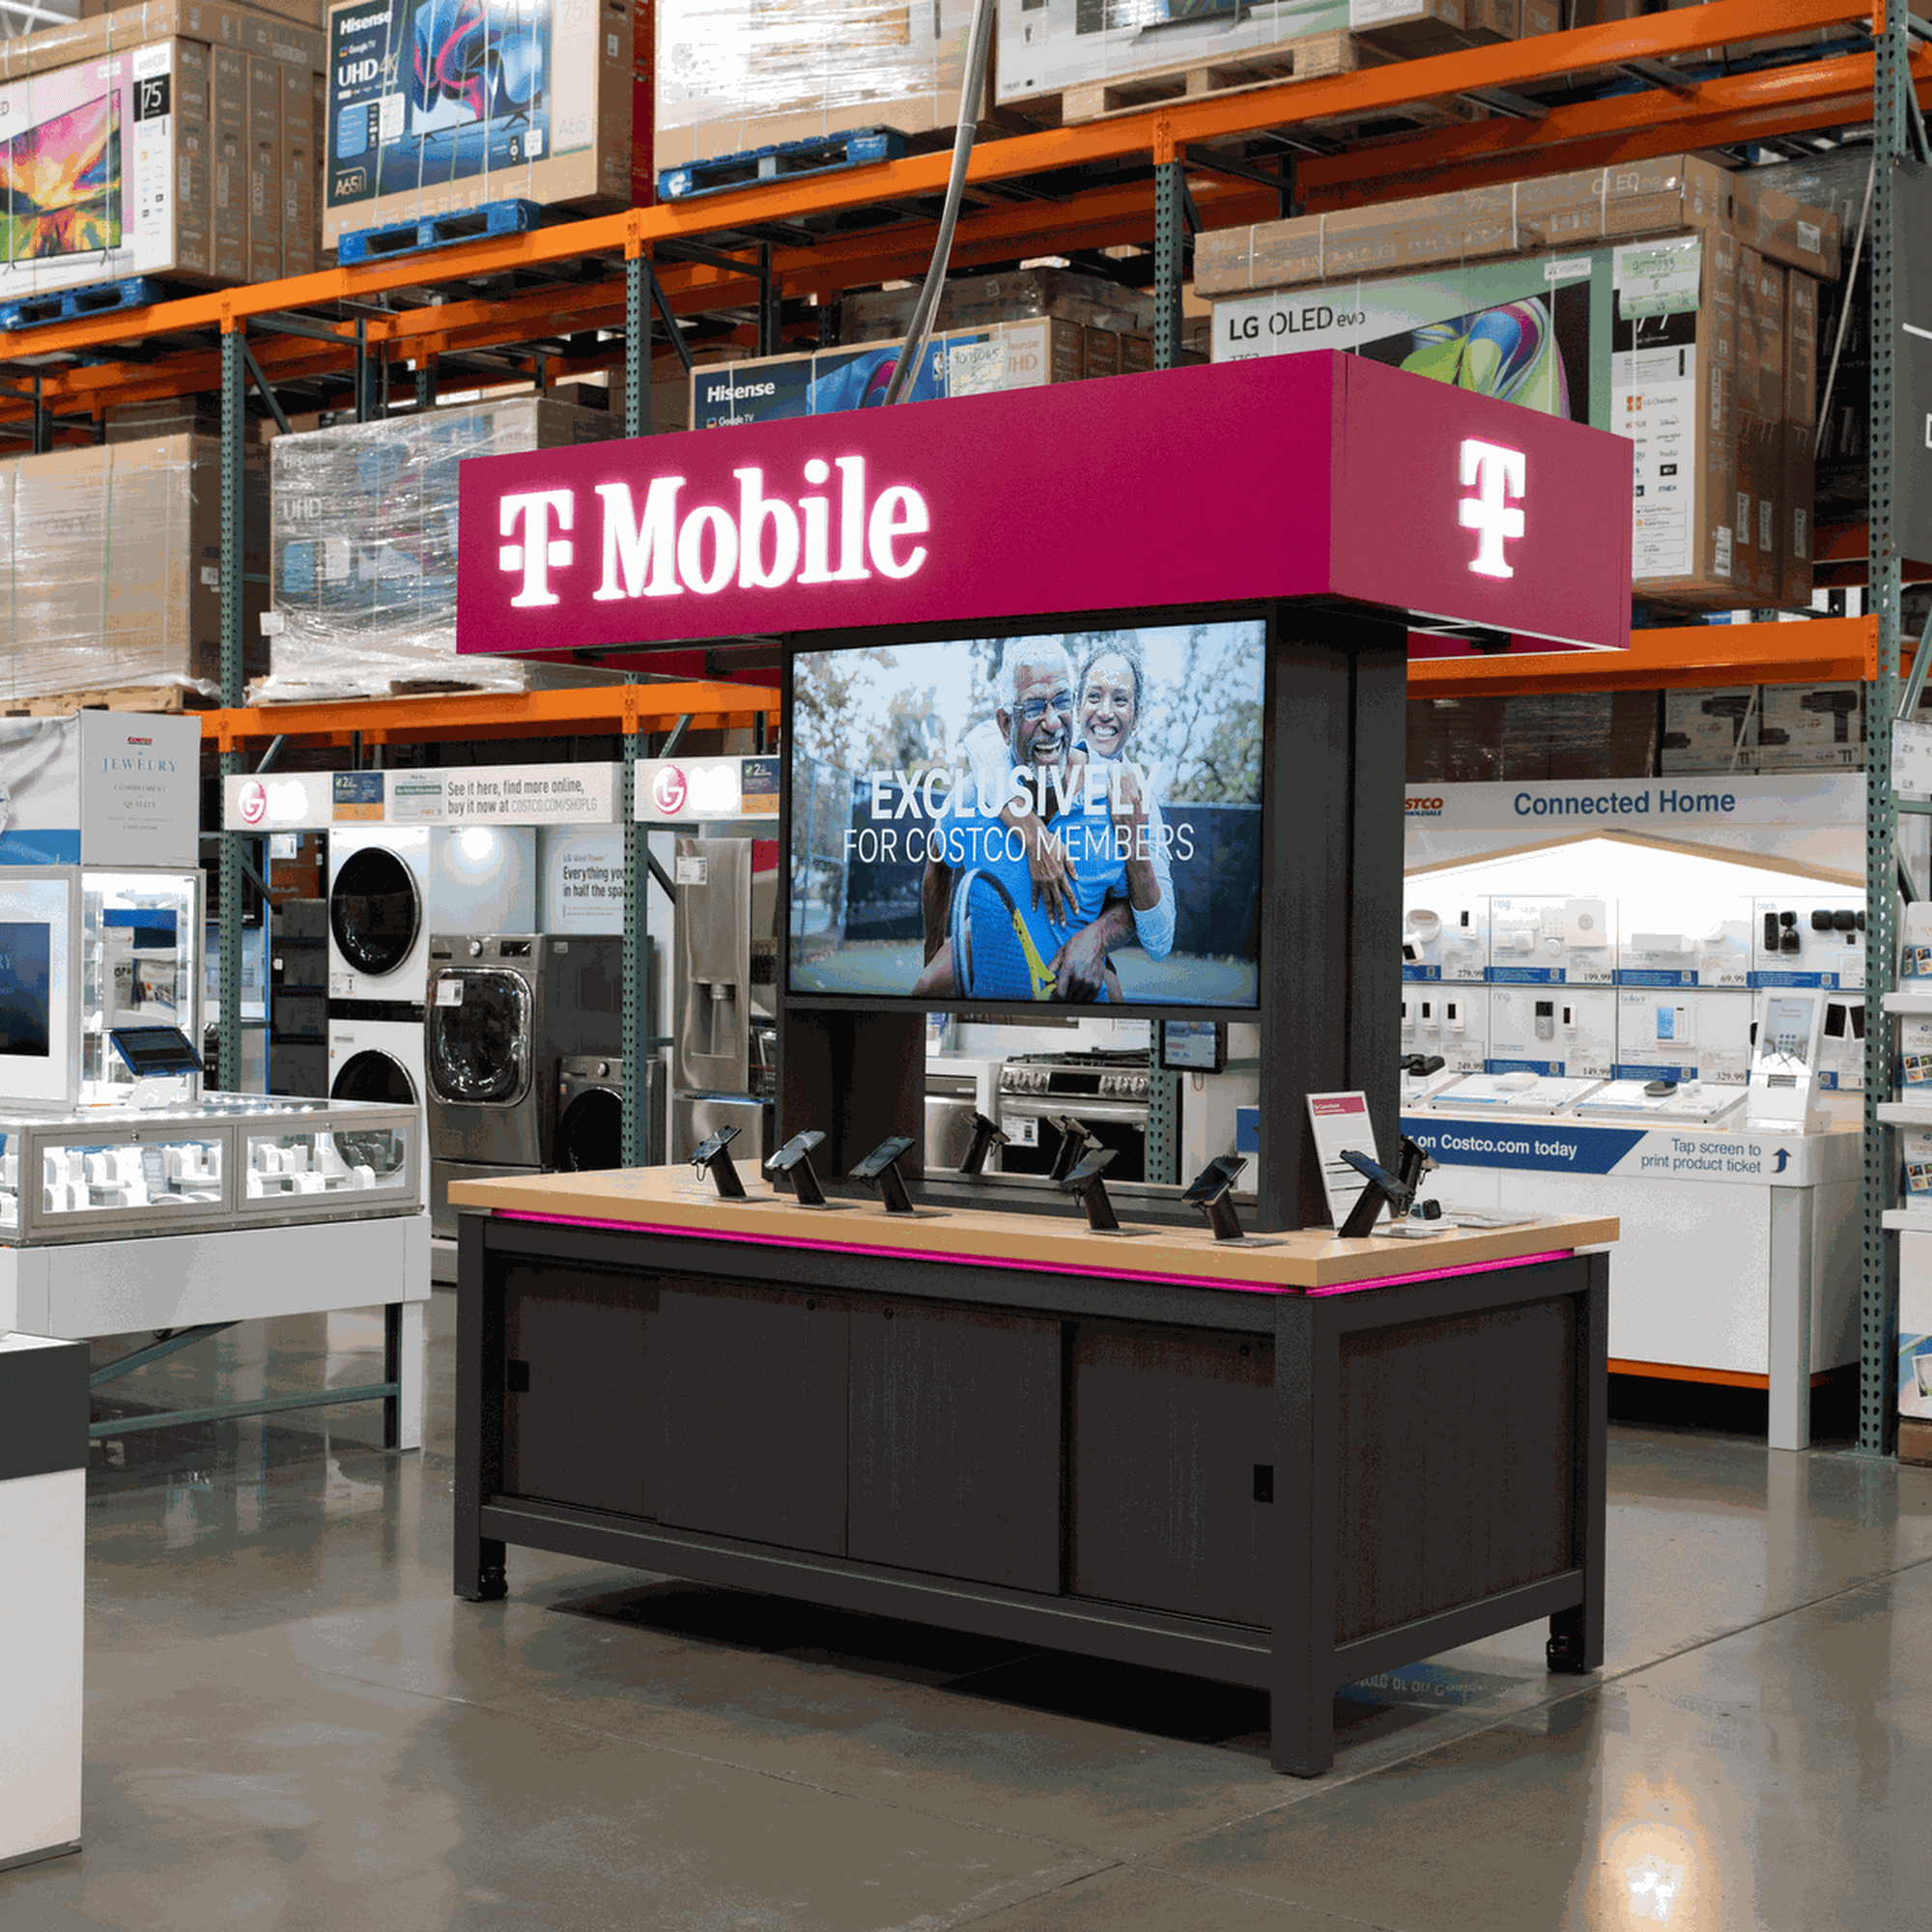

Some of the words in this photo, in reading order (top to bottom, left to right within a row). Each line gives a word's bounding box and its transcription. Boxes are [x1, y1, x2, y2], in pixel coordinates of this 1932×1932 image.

[340, 11, 390, 35] Hisense
[338, 59, 379, 87] UHD
[142, 80, 164, 109] 75
[1230, 316, 1259, 341] LG
[1268, 306, 1334, 335] OLED
[1337, 311, 1366, 327] evo
[707, 381, 776, 403] Hisense
[593, 455, 930, 602] Mobile
[100, 757, 177, 773] JEWELRY
[447, 781, 466, 797] See
[468, 781, 474, 795] it
[476, 780, 501, 797] here,
[503, 779, 522, 795] find
[525, 781, 549, 794] more
[552, 777, 584, 794] online,
[870, 762, 1160, 819] EXCLUSIVELY
[447, 800, 465, 817] buy
[468, 800, 474, 813] it
[476, 802, 497, 814] now
[499, 800, 509, 812] at
[1514, 789, 1650, 816] Connected
[1660, 789, 1736, 812] Home
[843, 829, 898, 863] FOR
[905, 826, 1027, 864] COSTCO
[1037, 823, 1196, 862] MEMBERS
[563, 866, 610, 883] Everything
[563, 883, 572, 896] in
[573, 883, 589, 897] half
[591, 883, 606, 897] the
[1583, 972, 1611, 981] 199.99
[1719, 974, 1745, 983] 69.99
[1458, 1062, 1484, 1071] 249.99
[1583, 1066, 1611, 1077] 149.99
[1715, 1070, 1745, 1081] 329.99
[1417, 1136, 1436, 1149] on
[1440, 1134, 1530, 1154] Costco.com
[1535, 1140, 1577, 1160] today
[1672, 1138, 1695, 1155] Tap
[1699, 1142, 1745, 1156] screen
[1749, 1143, 1762, 1157] to
[1641, 1153, 1669, 1170] print
[1673, 1156, 1723, 1172] product
[1726, 1160, 1761, 1174] ticket
